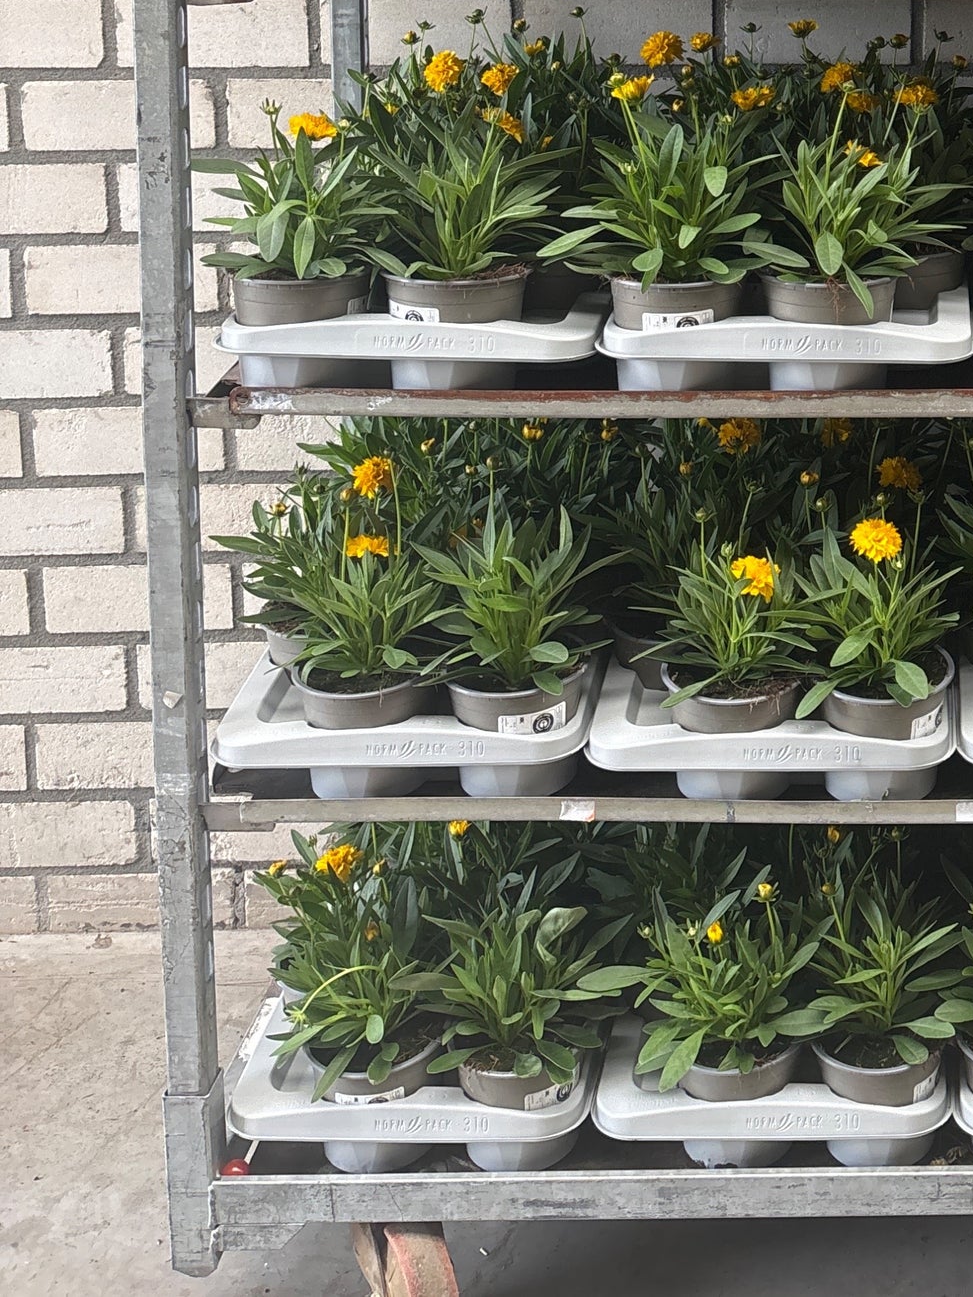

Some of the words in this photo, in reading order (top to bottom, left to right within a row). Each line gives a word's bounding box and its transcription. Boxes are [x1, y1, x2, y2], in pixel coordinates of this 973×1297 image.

[374, 336, 405, 349] NORM
[469, 336, 495, 352] 310
[761, 338, 793, 351] NORM
[855, 339, 881, 355] 310
[366, 744, 398, 756] NORM
[458, 741, 485, 758] 310
[743, 748, 774, 760] NORM
[375, 1119, 406, 1132] NORM
[464, 1117, 489, 1133] 310
[746, 1117, 776, 1129] NORM
[835, 1113, 860, 1131] 310
